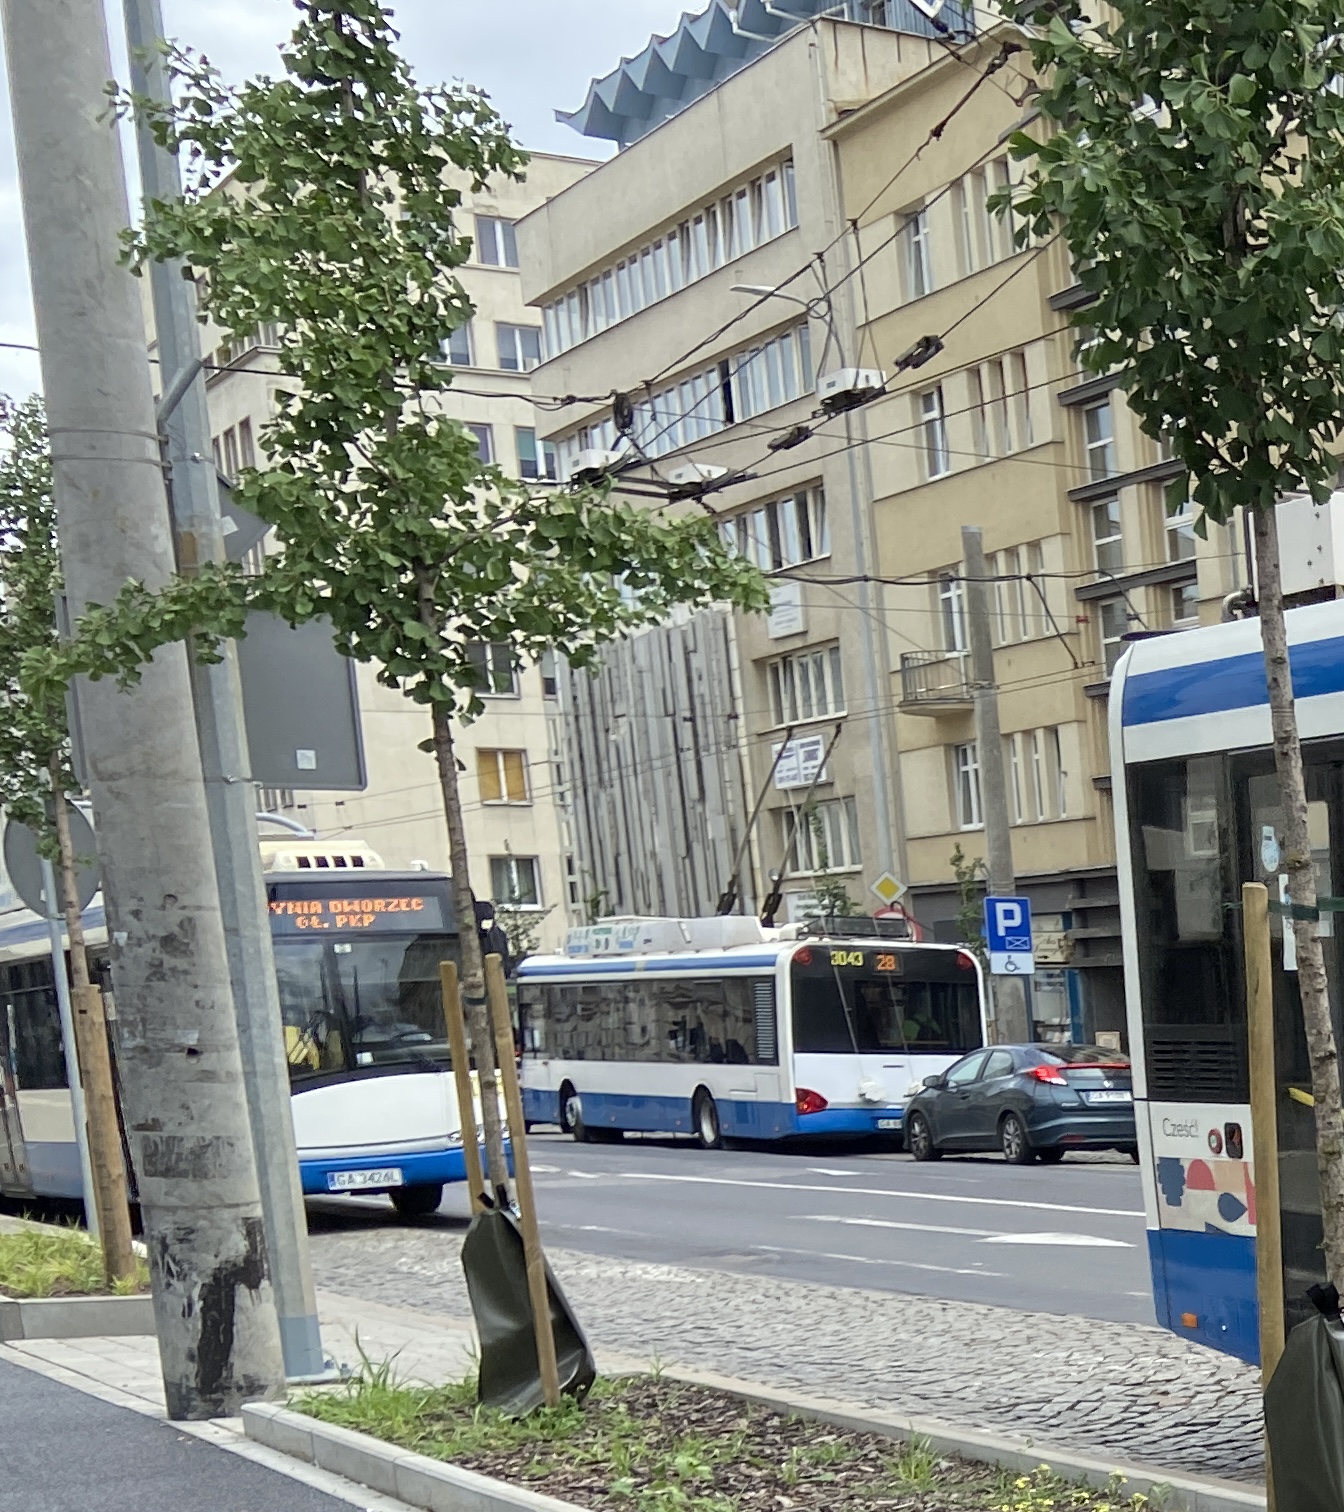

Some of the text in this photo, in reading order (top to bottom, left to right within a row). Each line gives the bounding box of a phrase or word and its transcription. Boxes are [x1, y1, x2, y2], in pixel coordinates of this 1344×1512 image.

[328, 897, 424, 913] DWORZEC
[335, 913, 377, 928] PKP
[995, 902, 1022, 936] P
[830, 950, 864, 966] 3043
[875, 954, 896, 971] 28
